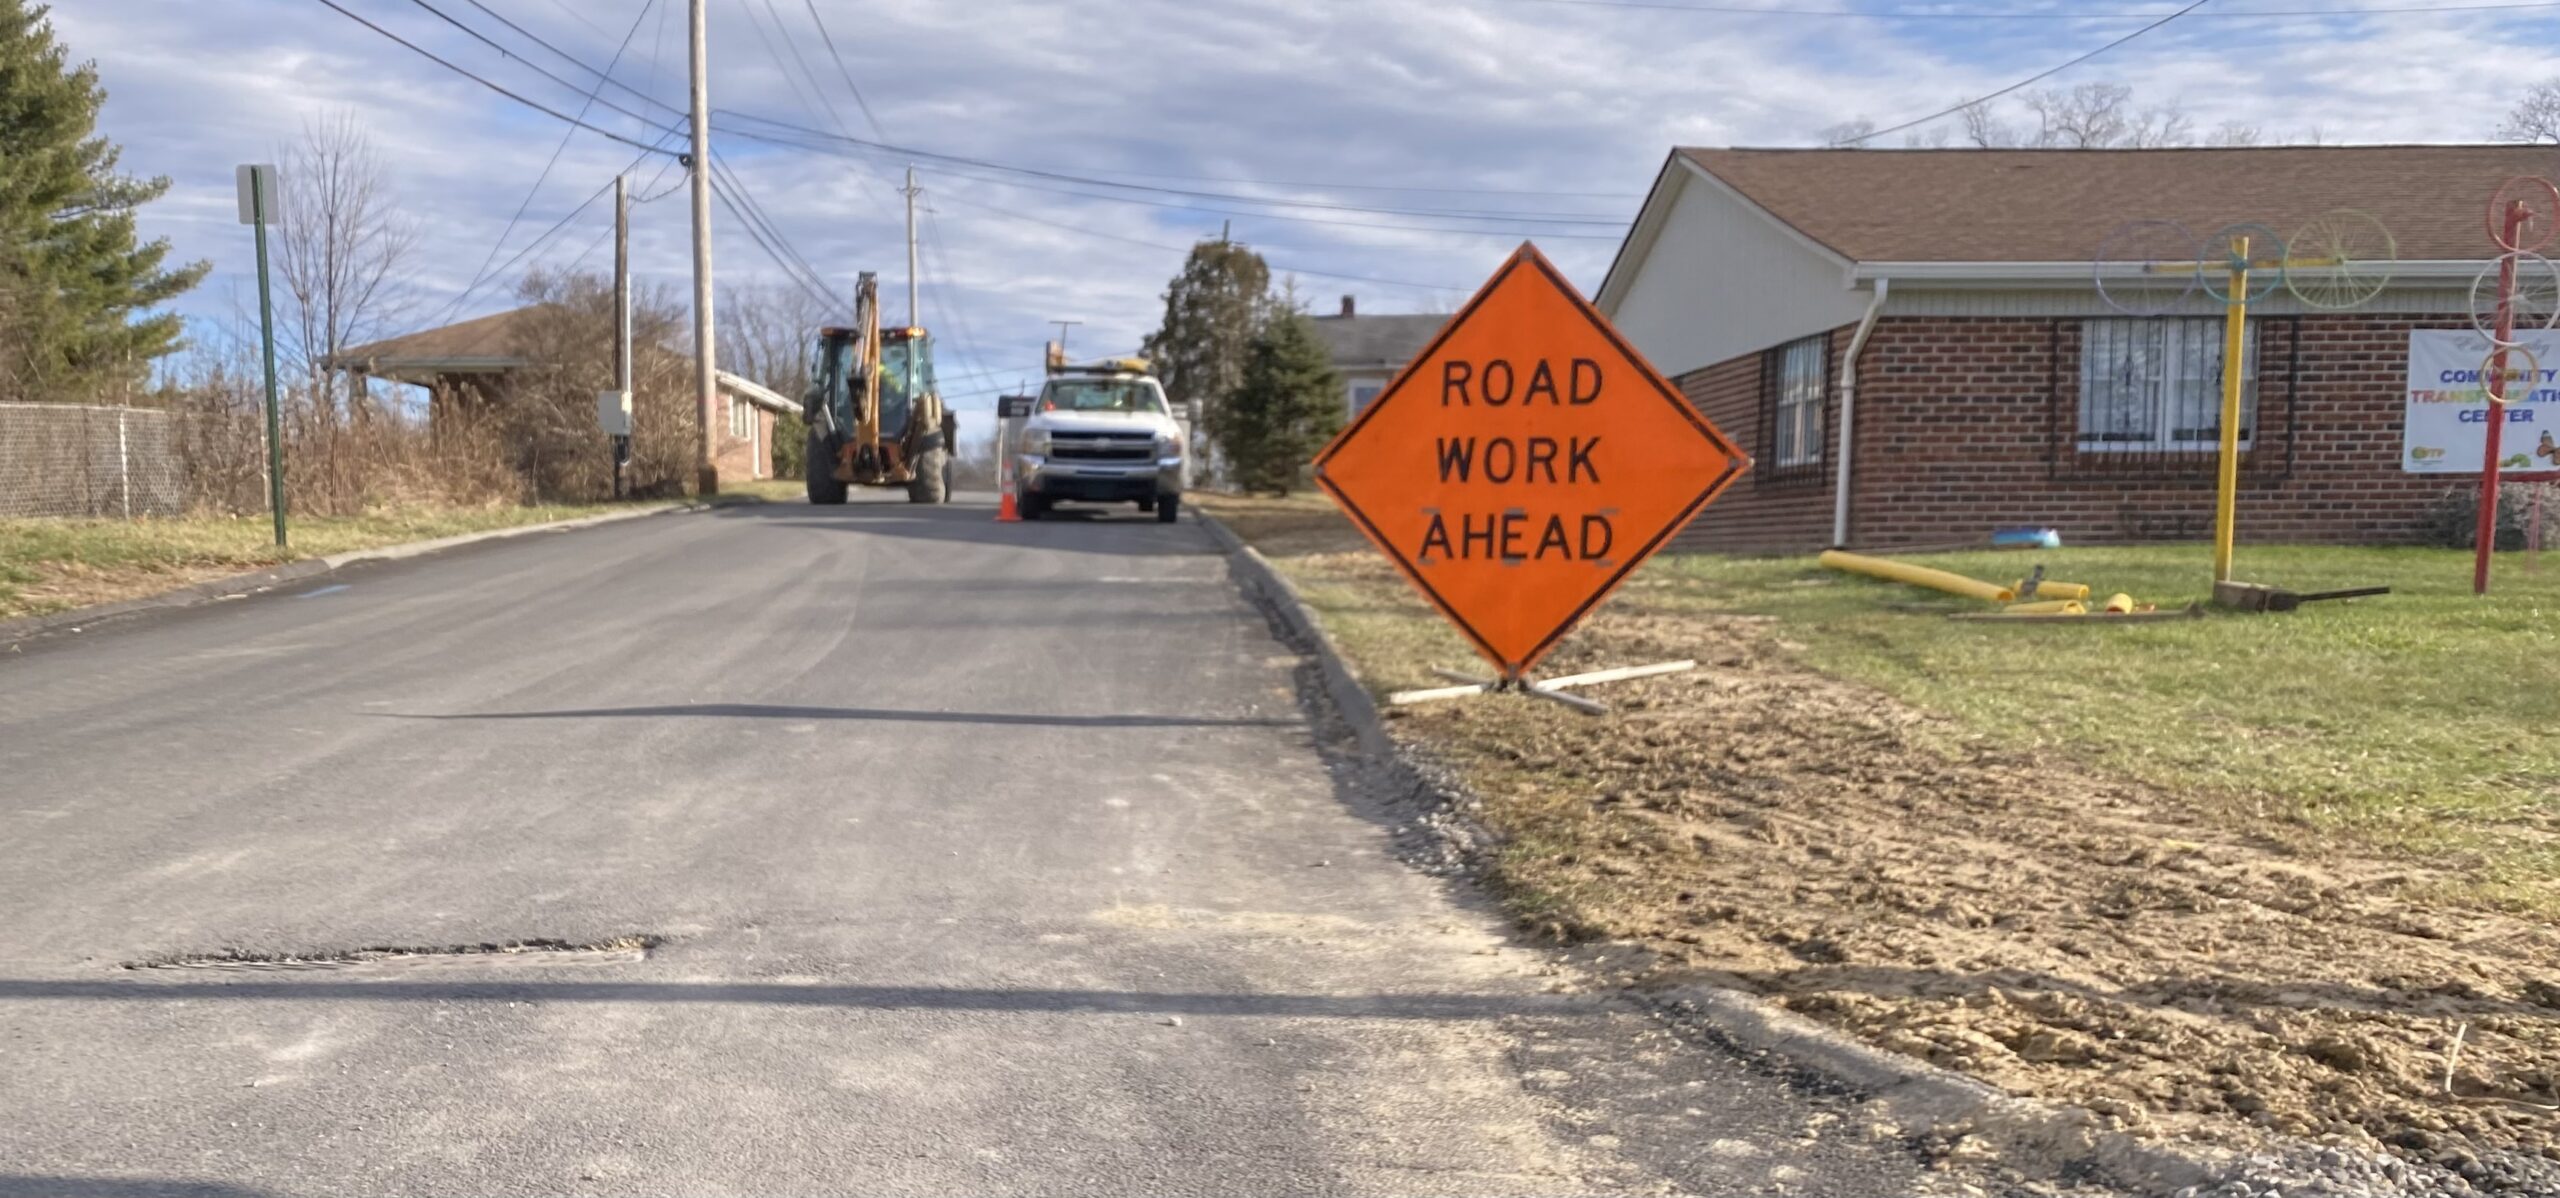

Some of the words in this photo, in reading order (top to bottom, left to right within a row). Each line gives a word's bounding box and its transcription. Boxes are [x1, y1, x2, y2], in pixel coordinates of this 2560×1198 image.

[1441, 358, 1603, 406] ROAD
[1436, 436, 1601, 484] WORK
[1418, 513, 1613, 560] AHEAD
